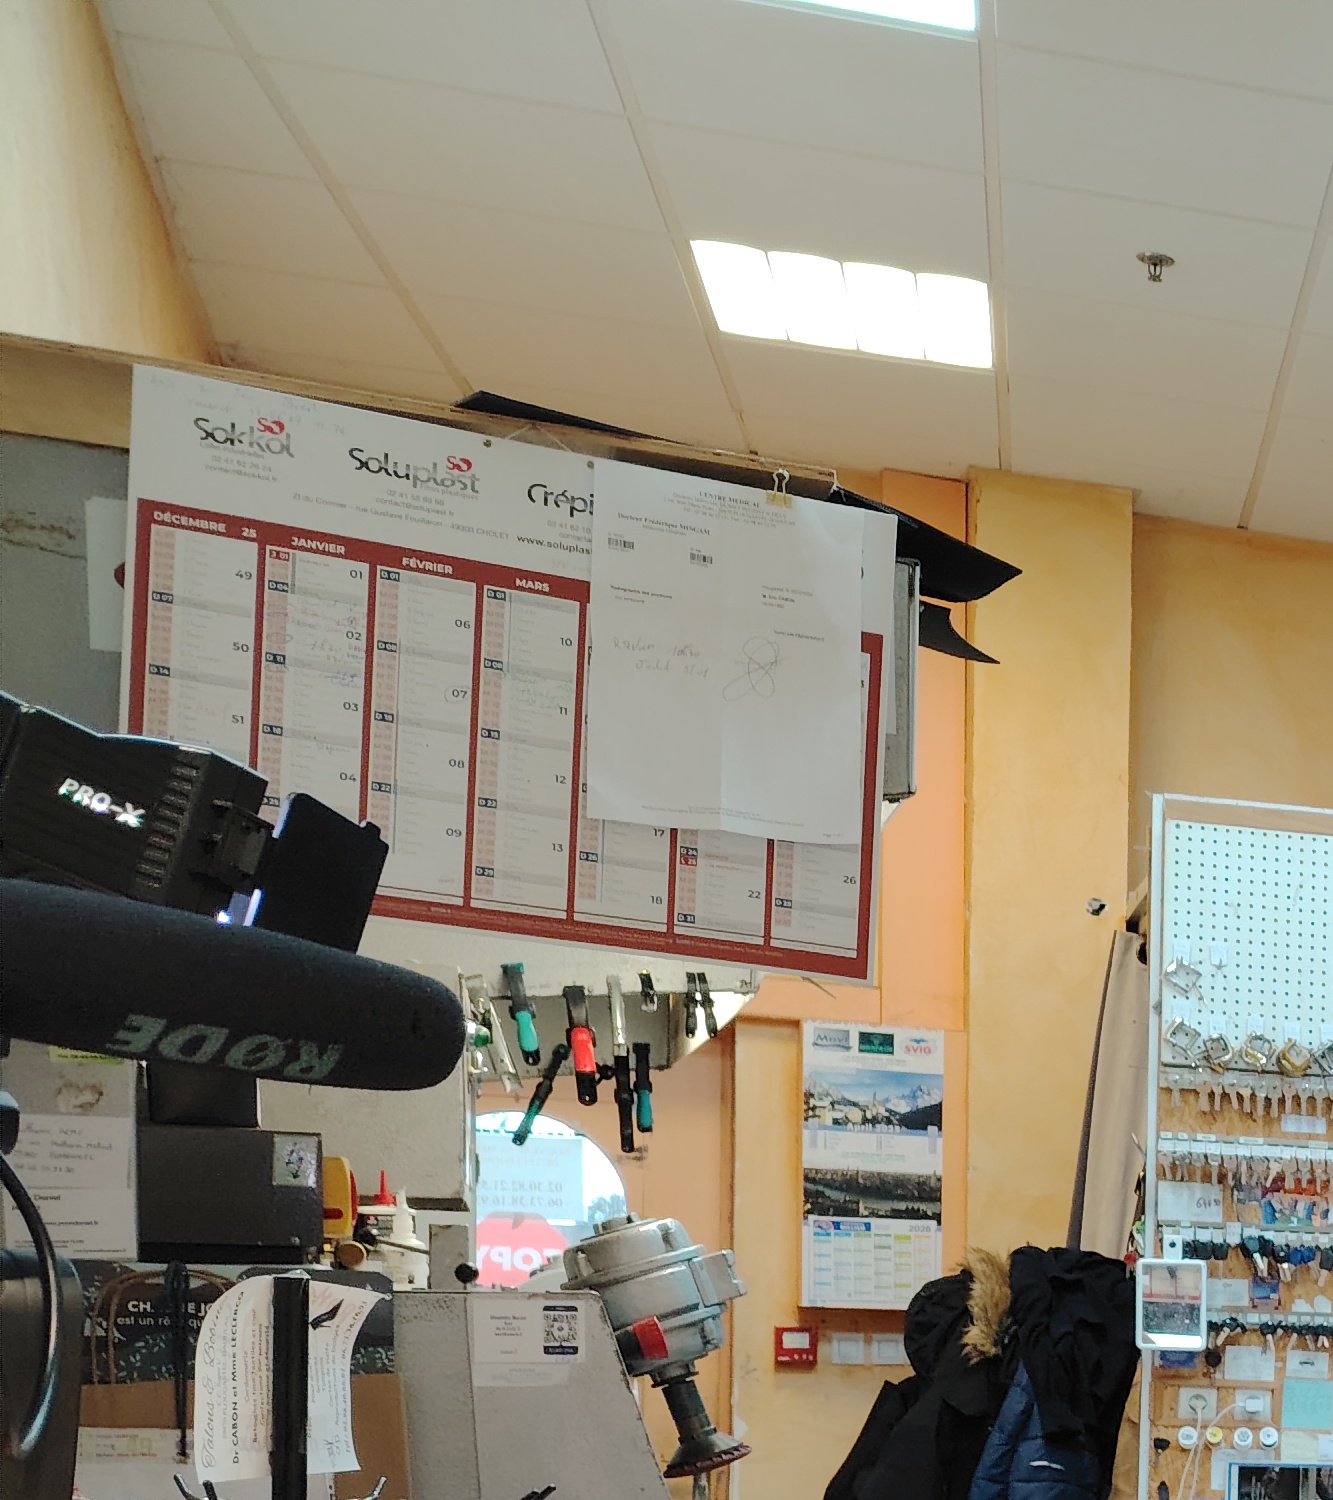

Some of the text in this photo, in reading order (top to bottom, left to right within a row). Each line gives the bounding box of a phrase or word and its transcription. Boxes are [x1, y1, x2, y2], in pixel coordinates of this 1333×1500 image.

[348, 447, 480, 495] Soluplast
[153, 509, 228, 534] DÉCEMBRE
[291, 536, 346, 555] JANVIER
[402, 555, 453, 576] FÉVRIER
[235, 568, 253, 581] 49
[349, 568, 364, 580] 01
[515, 577, 550, 592] MARS
[454, 617, 471, 630] 06
[559, 637, 573, 648] 10
[452, 687, 468, 699] 07
[555, 774, 567, 785] 12
[58, 777, 146, 828] PRO-X
[551, 842, 563, 853] 13
[747, 889, 761, 899] 22
[231, 1402, 239, 1447] CABON
